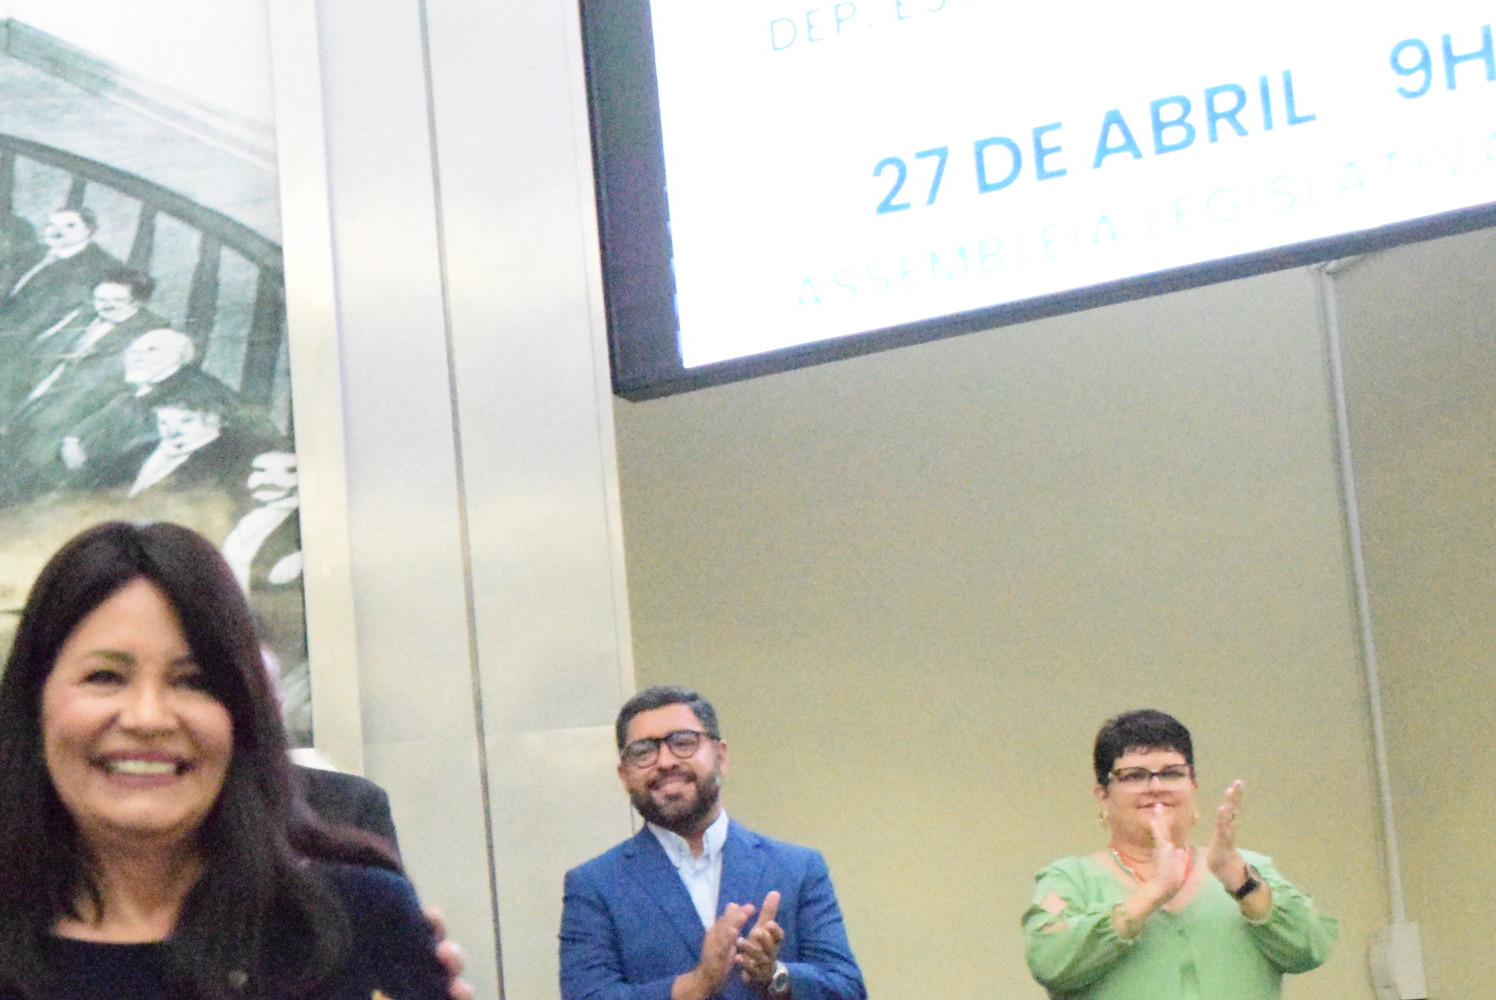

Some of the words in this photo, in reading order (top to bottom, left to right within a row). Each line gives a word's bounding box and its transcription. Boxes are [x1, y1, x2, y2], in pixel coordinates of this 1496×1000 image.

[870, 145, 950, 215] 27
[972, 121, 1069, 195] DE
[1091, 67, 1318, 169] ABRIL
